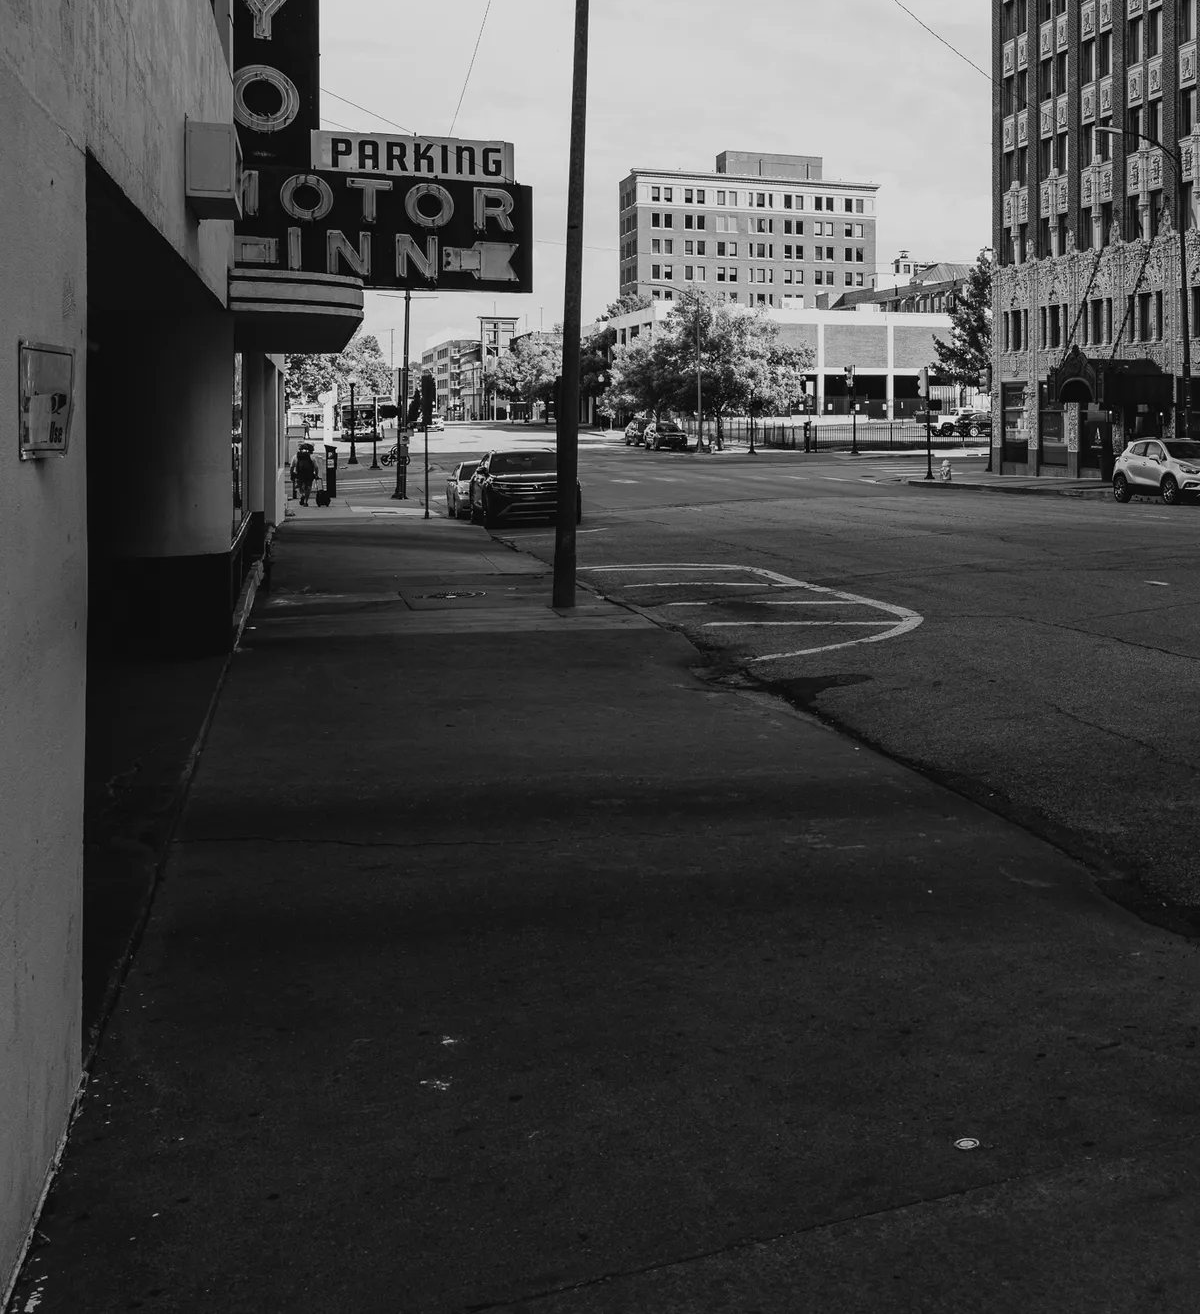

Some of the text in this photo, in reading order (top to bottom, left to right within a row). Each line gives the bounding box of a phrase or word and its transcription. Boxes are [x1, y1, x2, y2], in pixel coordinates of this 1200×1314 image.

[331, 137, 502, 177] PARKING
[287, 226, 439, 283] INN
[50, 421, 63, 443] Use
